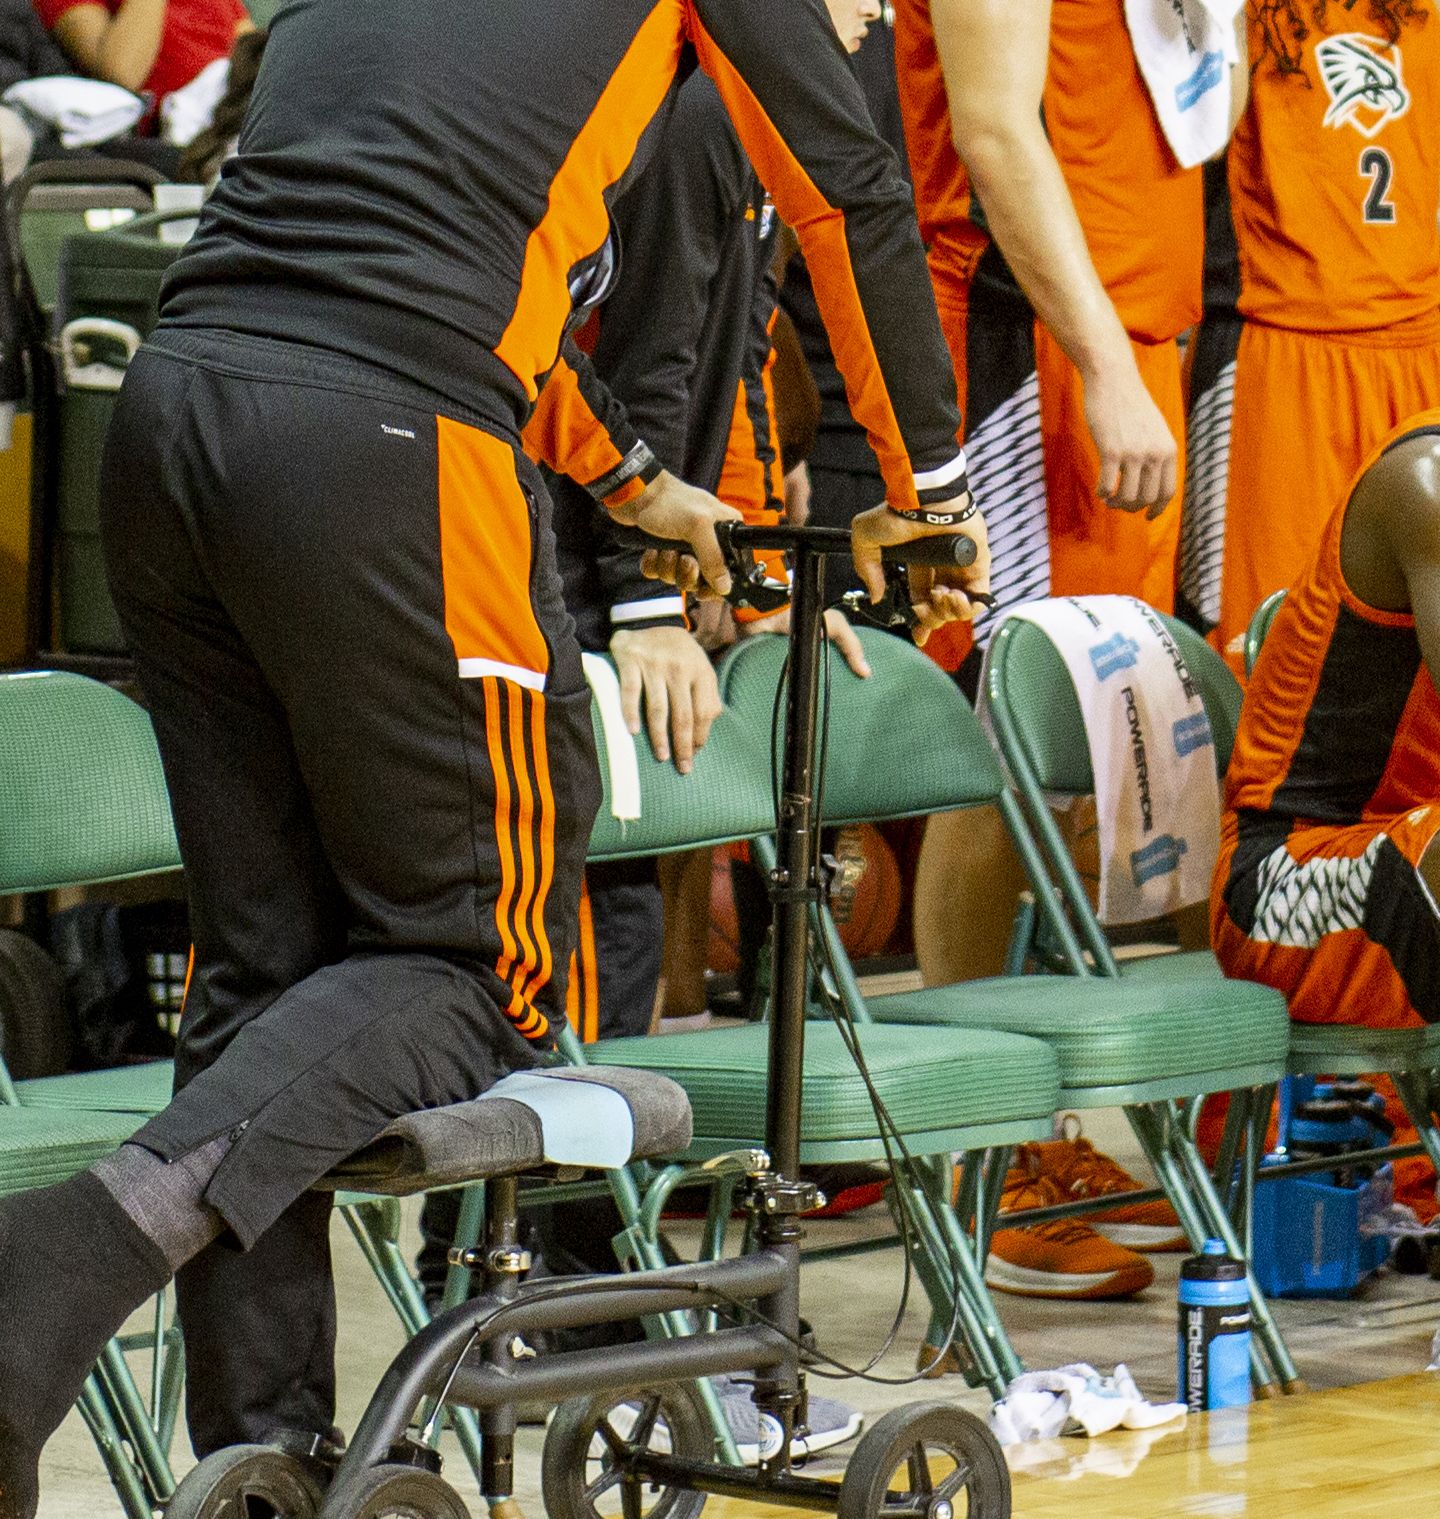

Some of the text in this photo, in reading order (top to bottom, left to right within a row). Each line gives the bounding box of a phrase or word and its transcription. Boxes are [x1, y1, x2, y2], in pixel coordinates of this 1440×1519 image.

[1358, 145, 1398, 225] 2
[1121, 685, 1153, 835] POWERADE
[1186, 1306, 1205, 1413] WERADE
